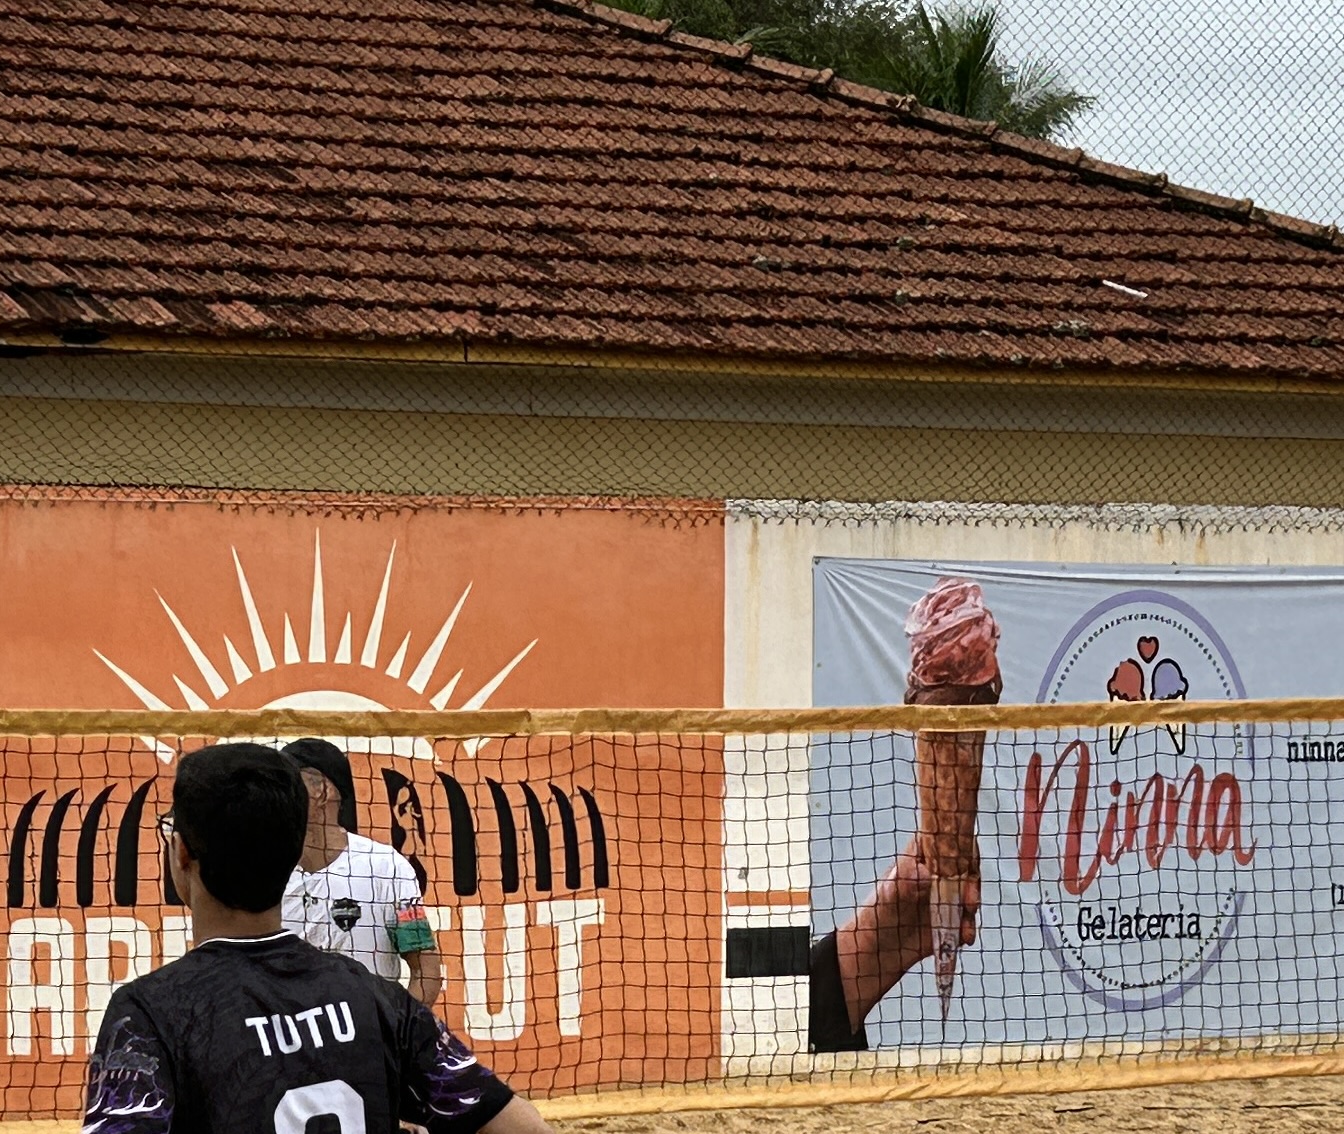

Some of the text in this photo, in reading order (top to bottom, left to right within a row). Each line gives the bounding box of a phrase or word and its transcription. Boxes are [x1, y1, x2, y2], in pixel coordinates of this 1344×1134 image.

[1017, 738, 1258, 897] Ninna
[1076, 904, 1202, 942] Gelateria
[244, 1001, 356, 1057] TUTU
